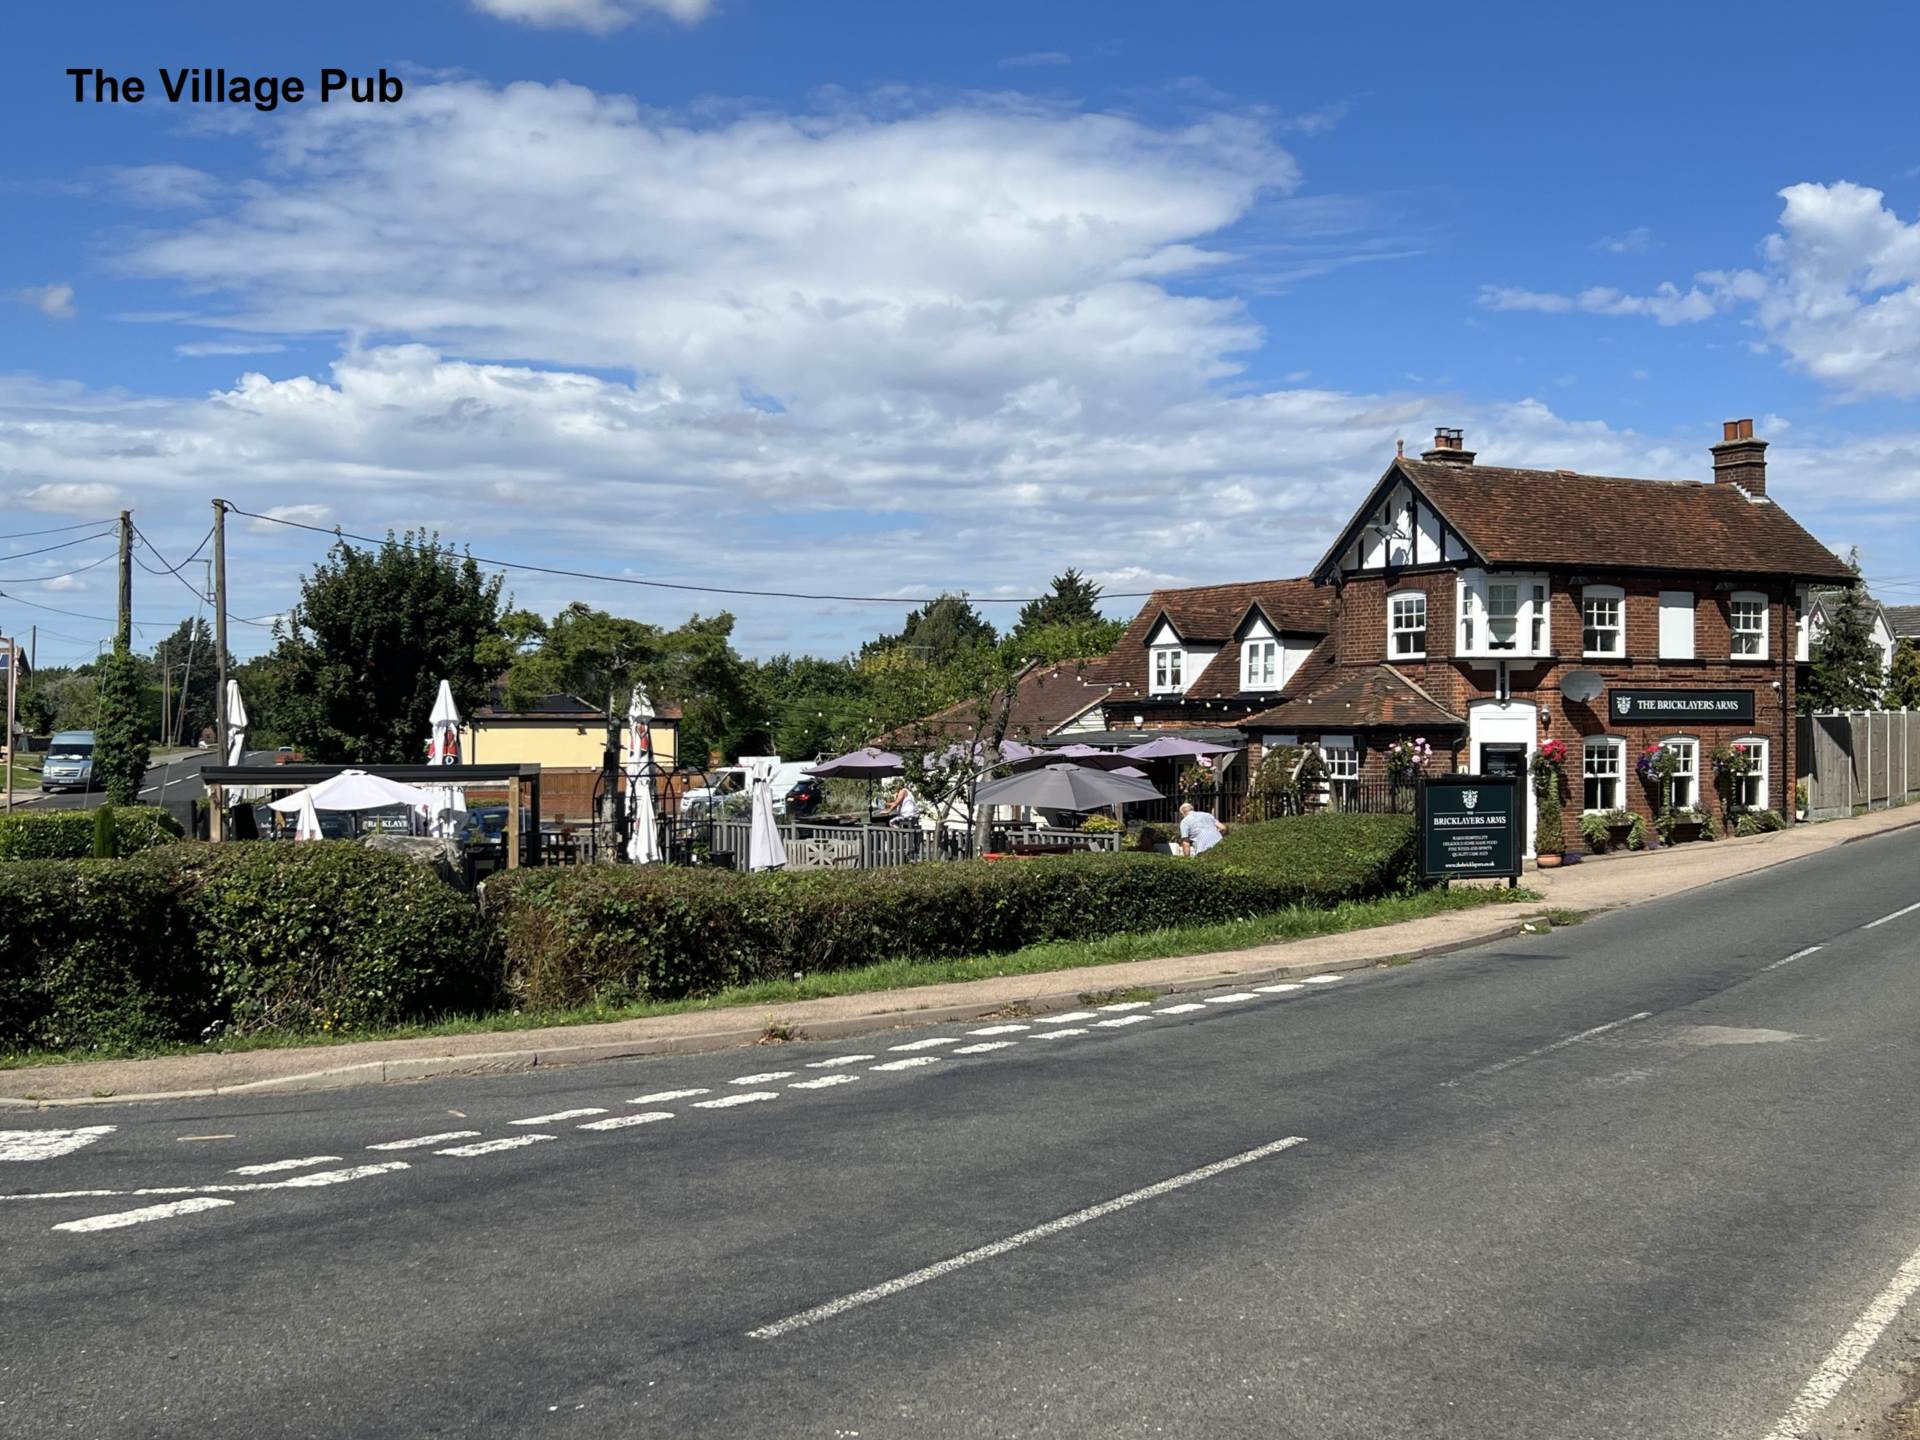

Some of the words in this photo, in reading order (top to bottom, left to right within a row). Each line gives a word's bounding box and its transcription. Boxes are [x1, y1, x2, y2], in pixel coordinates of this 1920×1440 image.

[1637, 700, 1656, 710] THE
[1657, 700, 1714, 710] BRICKLAYERS
[1715, 700, 1738, 710] ARMS
[1433, 817, 1485, 826] BRICKLAYERS
[1486, 816, 1506, 824] ARMS
